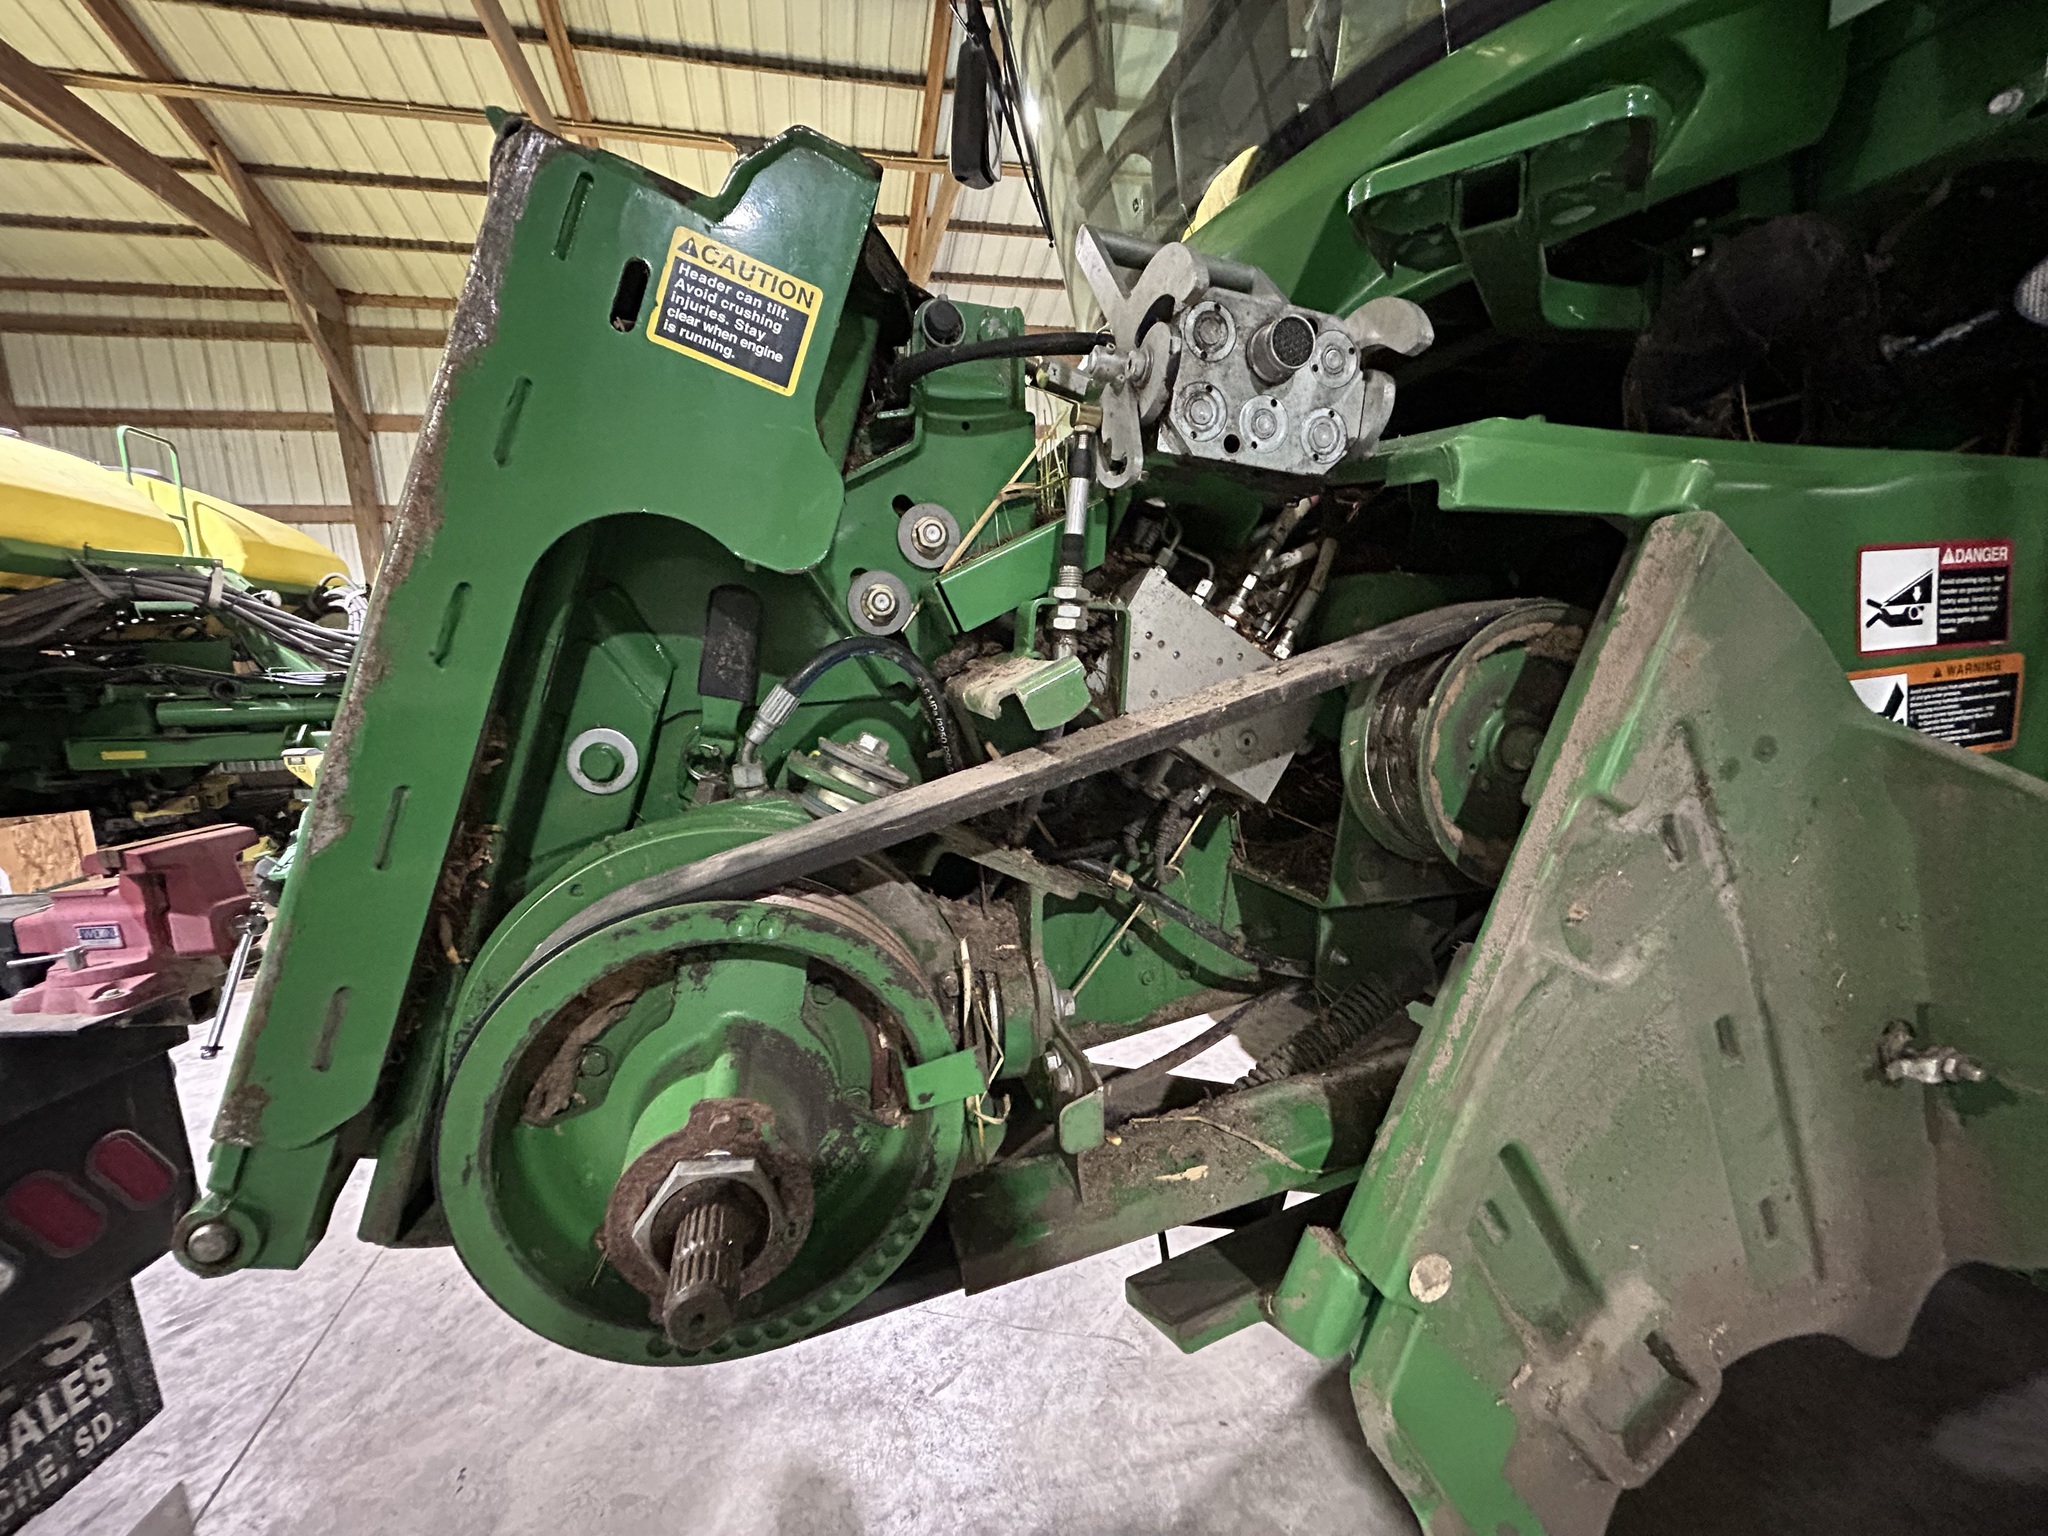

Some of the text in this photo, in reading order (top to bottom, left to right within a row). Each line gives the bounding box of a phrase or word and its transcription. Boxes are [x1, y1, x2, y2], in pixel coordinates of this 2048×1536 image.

[679, 262, 790, 321] Header can tilt.
[701, 244, 815, 309] CAUTION
[670, 291, 767, 342] injuries. Stay
[674, 278, 782, 335] Avoid crushing
[663, 319, 736, 359] is running.
[667, 307, 784, 363] clear when engine
[1955, 546, 2008, 564] DANGER
[1946, 660, 2001, 676] WARNING
